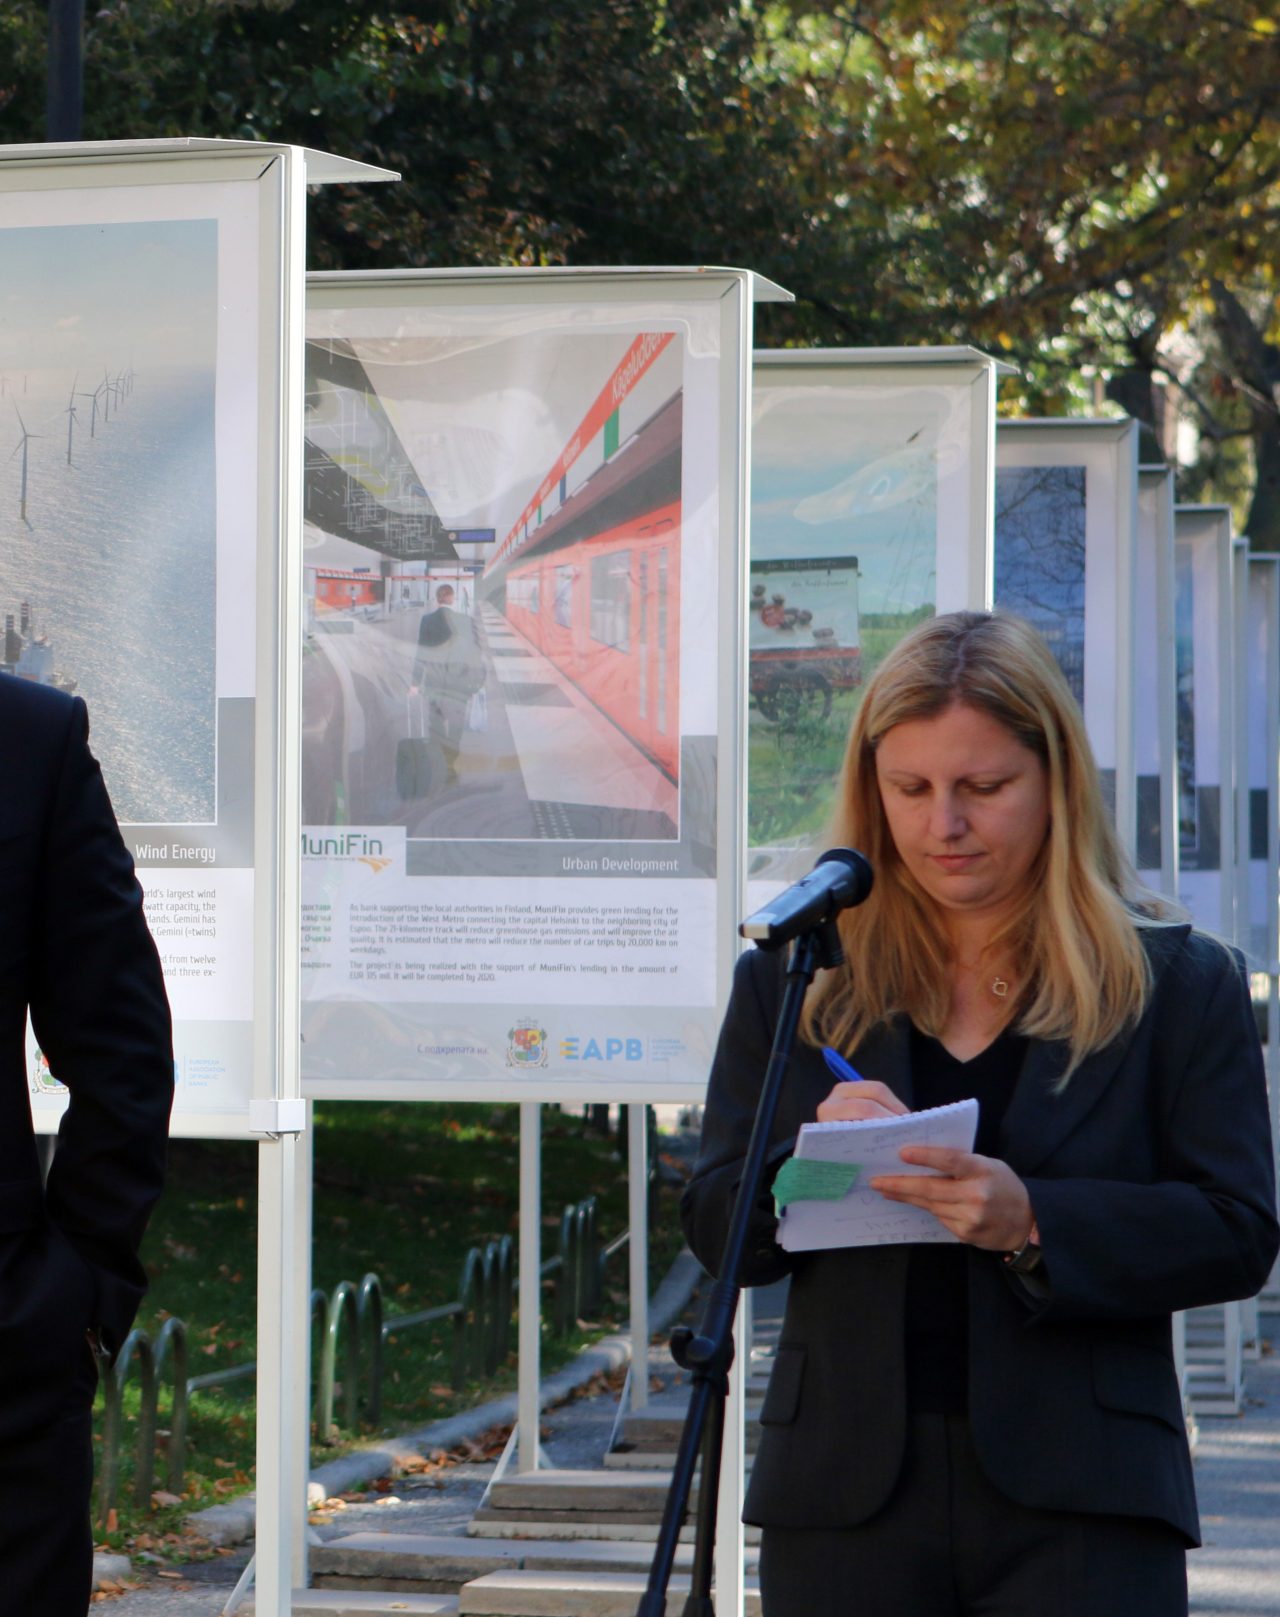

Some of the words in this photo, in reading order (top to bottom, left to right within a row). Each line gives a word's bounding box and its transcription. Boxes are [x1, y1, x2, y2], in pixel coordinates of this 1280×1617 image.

[135, 844, 167, 859] Wind
[172, 844, 216, 863] Energy
[562, 857, 598, 870] Urban
[602, 858, 679, 873] Development
[166, 889, 194, 901] largest
[197, 889, 216, 898] wind
[166, 902, 200, 913] capacity,
[202, 902, 216, 911] the
[380, 904, 419, 914] supporting
[435, 904, 452, 912] local
[454, 905, 494, 913] authorities
[568, 906, 598, 916] provides
[601, 908, 621, 916] green
[624, 906, 650, 916] lending
[666, 907, 678, 915] the
[174, 914, 200, 923] Gemini
[202, 914, 216, 923] has
[443, 915, 464, 923] Metro
[467, 915, 505, 925] connecting
[524, 916, 548, 926] capital
[551, 916, 579, 924] Helsinki
[582, 916, 589, 924] to
[607, 917, 650, 927] neighboring
[654, 917, 668, 927] city
[671, 917, 678, 925] of
[156, 927, 183, 936] Gemini
[185, 927, 216, 938] (=twins)
[470, 926, 494, 934] reduce
[496, 926, 537, 936] greenhouse
[540, 928, 552, 936] gas
[555, 927, 590, 935] emissions
[592, 927, 605, 935] and
[608, 927, 620, 935] will
[623, 928, 651, 937] improve
[654, 928, 666, 936] the
[668, 928, 678, 936] air
[395, 936, 430, 944] estimated
[433, 936, 448, 944] that
[451, 936, 462, 944] the
[504, 937, 527, 945] reduce
[530, 937, 541, 945] the
[544, 937, 571, 945] number
[598, 938, 614, 947] trips
[617, 938, 625, 948] by
[656, 938, 666, 946] km
[169, 955, 188, 964] from
[190, 955, 216, 964] twelve
[180, 968, 200, 976] three
[461, 963, 476, 971] with
[481, 963, 492, 971] the
[496, 963, 524, 973] support
[540, 964, 576, 972] MuniFin's
[580, 964, 606, 974] lending
[622, 965, 633, 973] the
[638, 965, 665, 973] amount
[427, 972, 463, 982] completed
[560, 1037, 643, 1061] EAPB
